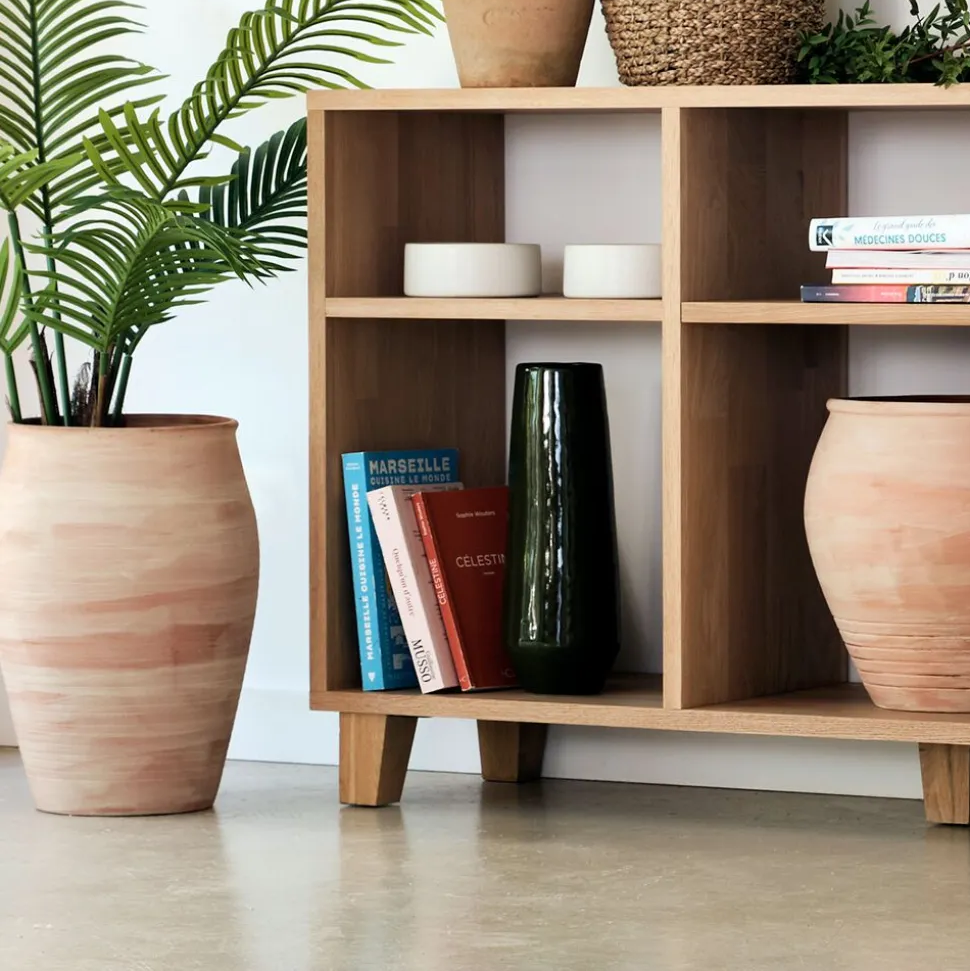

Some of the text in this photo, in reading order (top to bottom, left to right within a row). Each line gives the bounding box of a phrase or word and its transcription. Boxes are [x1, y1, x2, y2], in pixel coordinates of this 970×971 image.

[854, 233, 947, 245] MÉDECINES DOUCES
[369, 457, 451, 475] MARSEILLE
[370, 473, 451, 486] CUISINE LE MONDE
[351, 483, 362, 523] MONDE
[355, 526, 363, 540] LE
[357, 542, 369, 592] CUISINE
[361, 595, 375, 661] MARSEILLE
[411, 638, 432, 684] MUSSO
